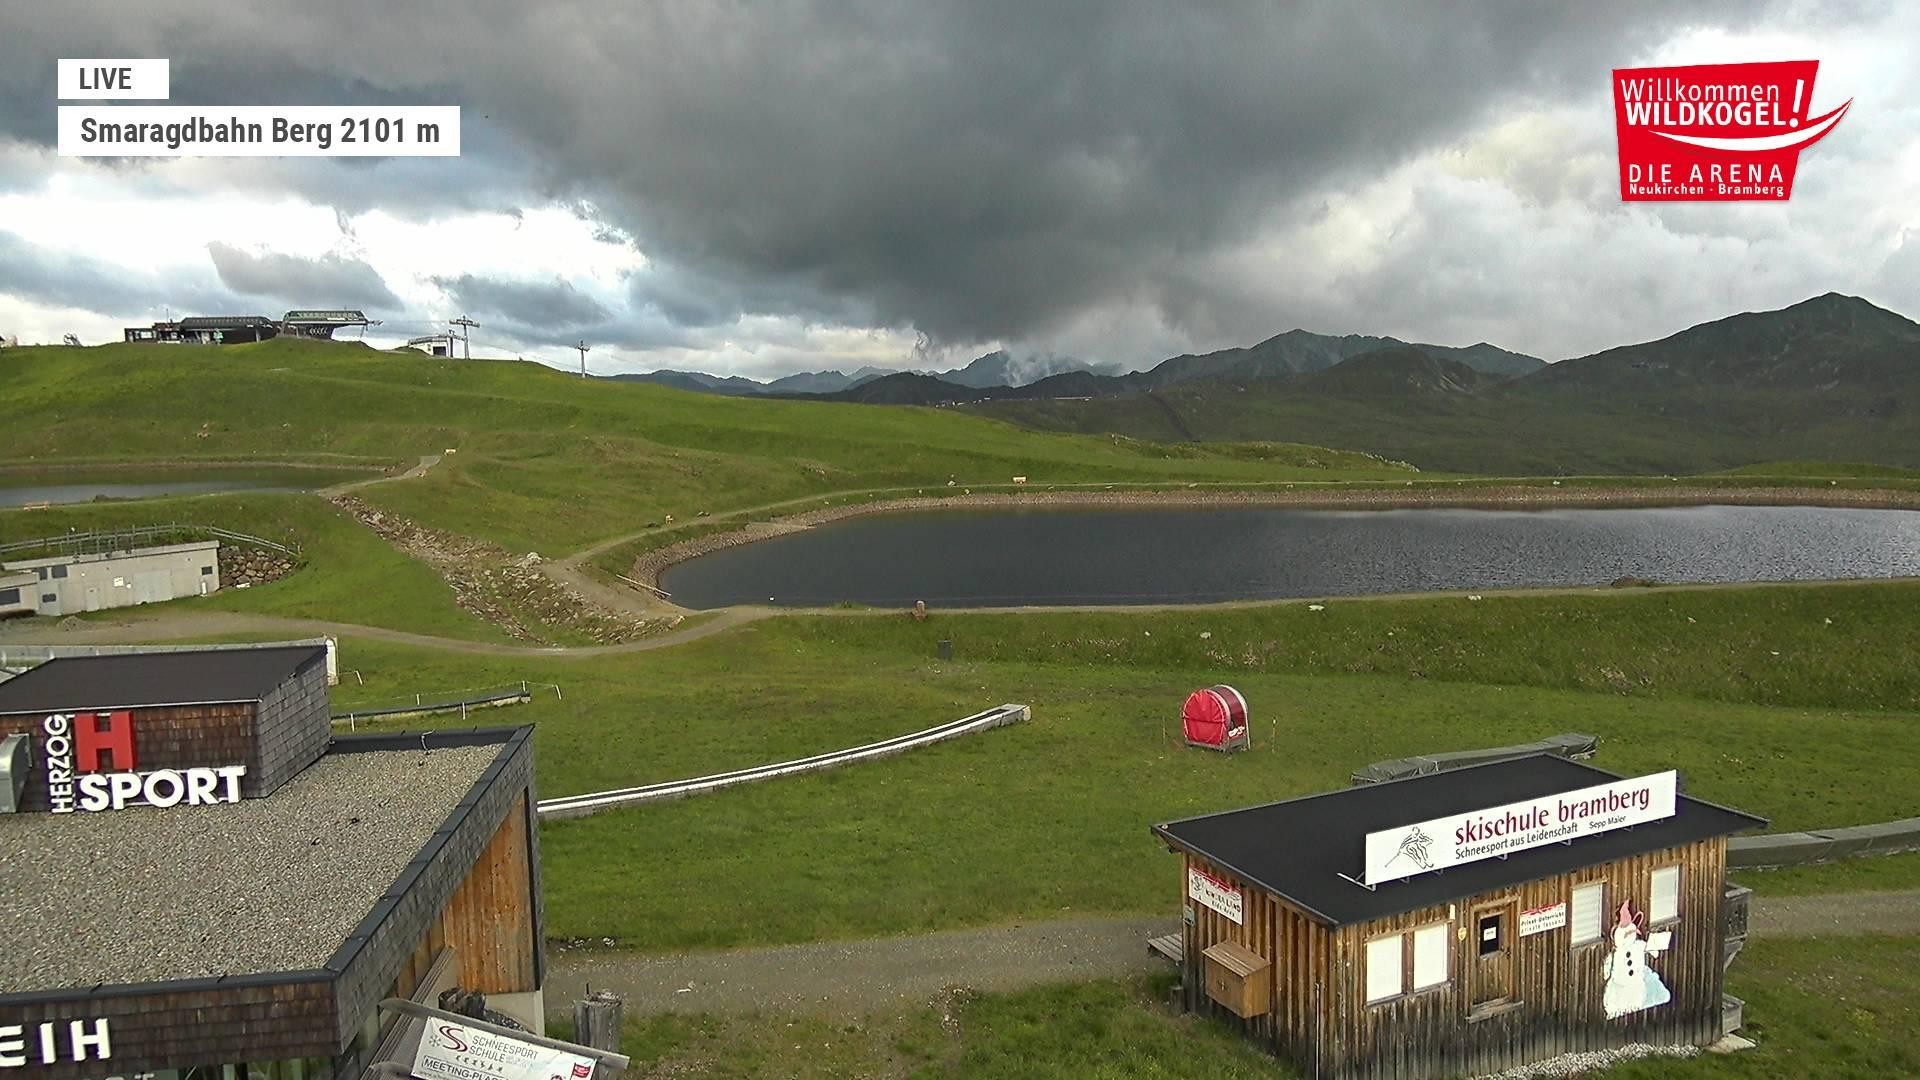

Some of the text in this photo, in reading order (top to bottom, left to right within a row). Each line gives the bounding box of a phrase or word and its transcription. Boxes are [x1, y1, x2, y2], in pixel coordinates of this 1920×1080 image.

[74, 710, 138, 773] H
[44, 713, 74, 814] HERZOG
[80, 765, 247, 812] SPORT
[1455, 788, 1650, 845] skischule bramberg
[1589, 815, 1627, 831] Sepp Maier
[1455, 824, 1578, 860] Schneesport aus Leidenschaft
[468, 1045, 506, 1063] SCHULE
[471, 1035, 539, 1060] SCHNEESPORT
